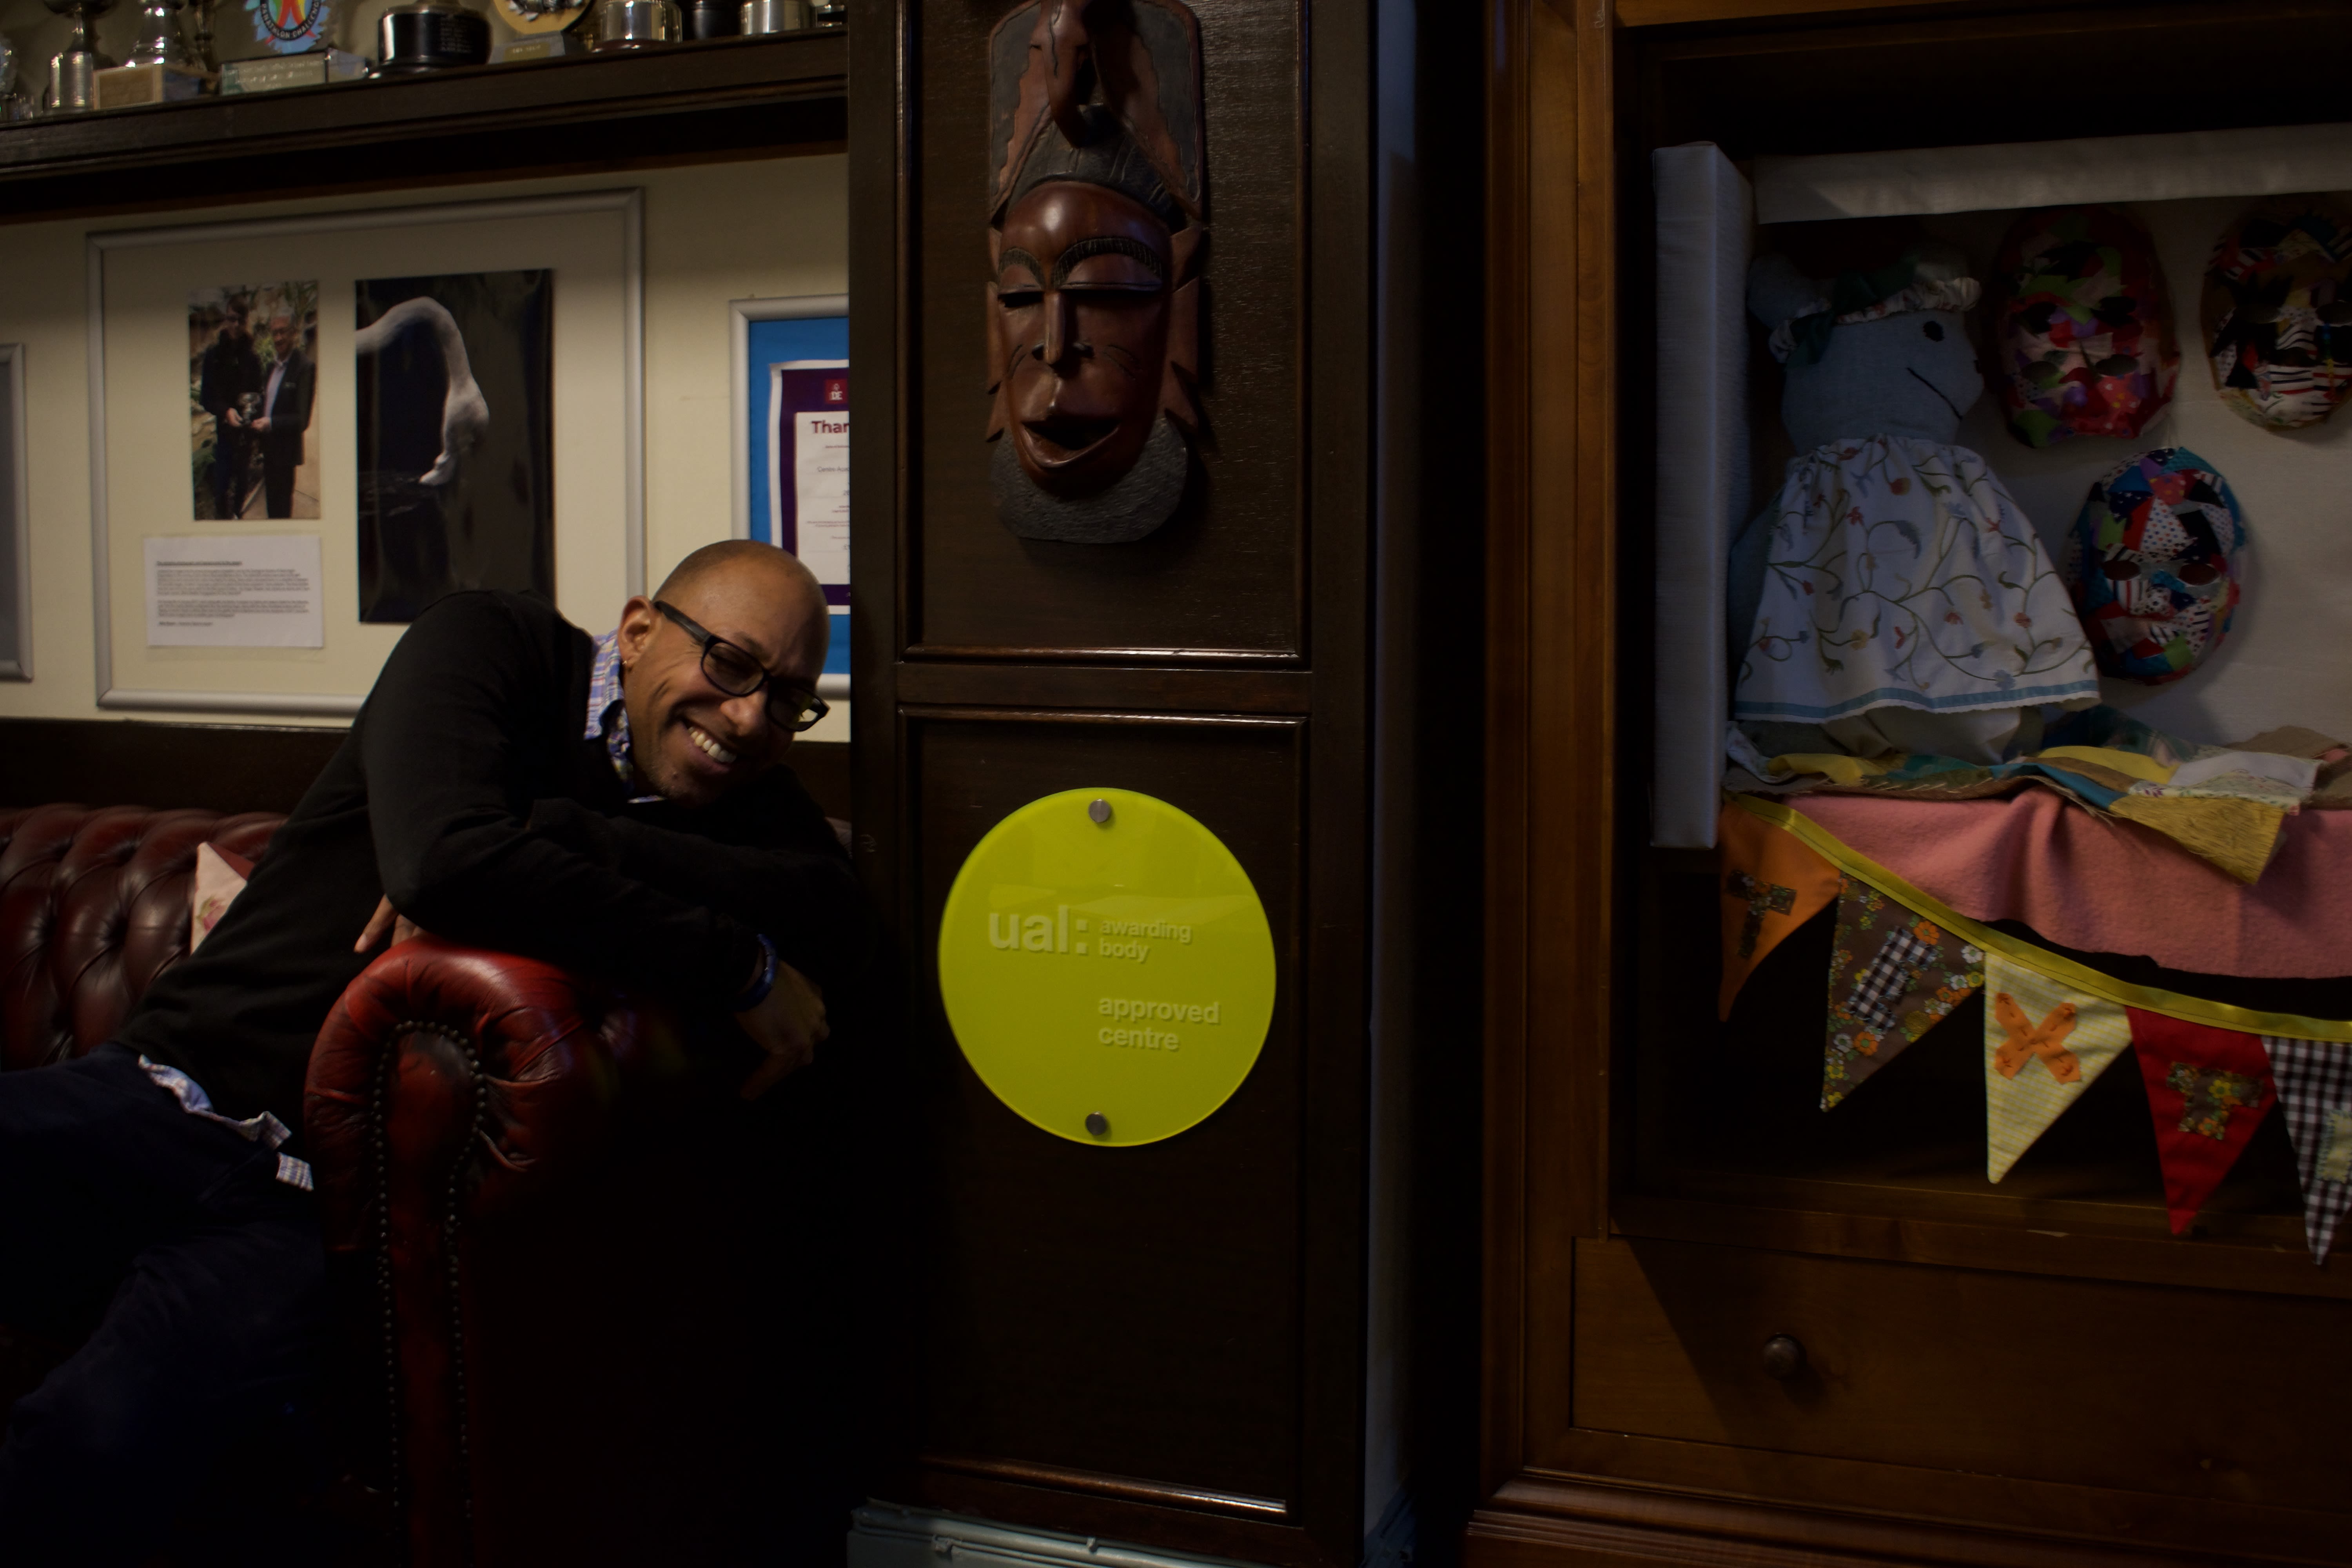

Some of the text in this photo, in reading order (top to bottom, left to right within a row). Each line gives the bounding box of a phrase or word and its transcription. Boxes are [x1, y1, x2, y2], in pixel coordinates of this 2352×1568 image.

[988, 904, 1088, 954] ual:
[1099, 918, 1192, 944] awarding
[1098, 938, 1149, 963] body
[1098, 997, 1220, 1024] approved
[1098, 1026, 1179, 1051] centre
